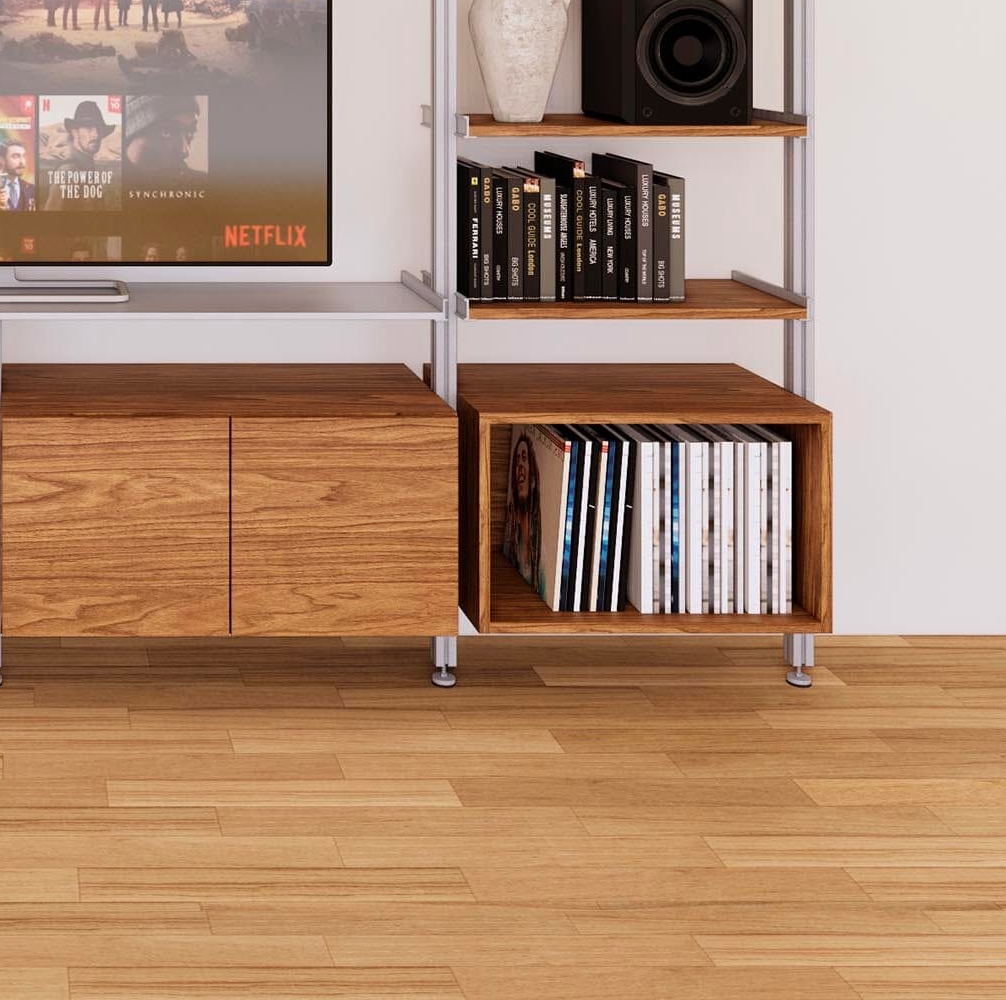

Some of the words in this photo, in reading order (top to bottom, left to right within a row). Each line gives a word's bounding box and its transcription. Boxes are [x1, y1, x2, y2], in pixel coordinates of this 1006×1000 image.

[48, 170, 66, 184] THE
[68, 170, 99, 184] POWER
[101, 170, 113, 184] OF
[641, 175, 649, 200] LUXURY
[60, 185, 80, 198] THE
[84, 185, 103, 198] DOG
[129, 190, 205, 198] SYNCHRONIC
[512, 187, 520, 211] GABO
[589, 186, 597, 208] LUXURY
[528, 203, 536, 223] COOL
[641, 200, 649, 227] HOUSES
[658, 194, 666, 216] GABO
[543, 194, 551, 239] MUSEUMS
[589, 210, 597, 232] HOTELS
[672, 194, 680, 239] MUSEUMS
[224, 224, 306, 248] NETFLIX
[528, 225, 536, 247] GUIDE
[589, 239, 597, 264] AMERICA
